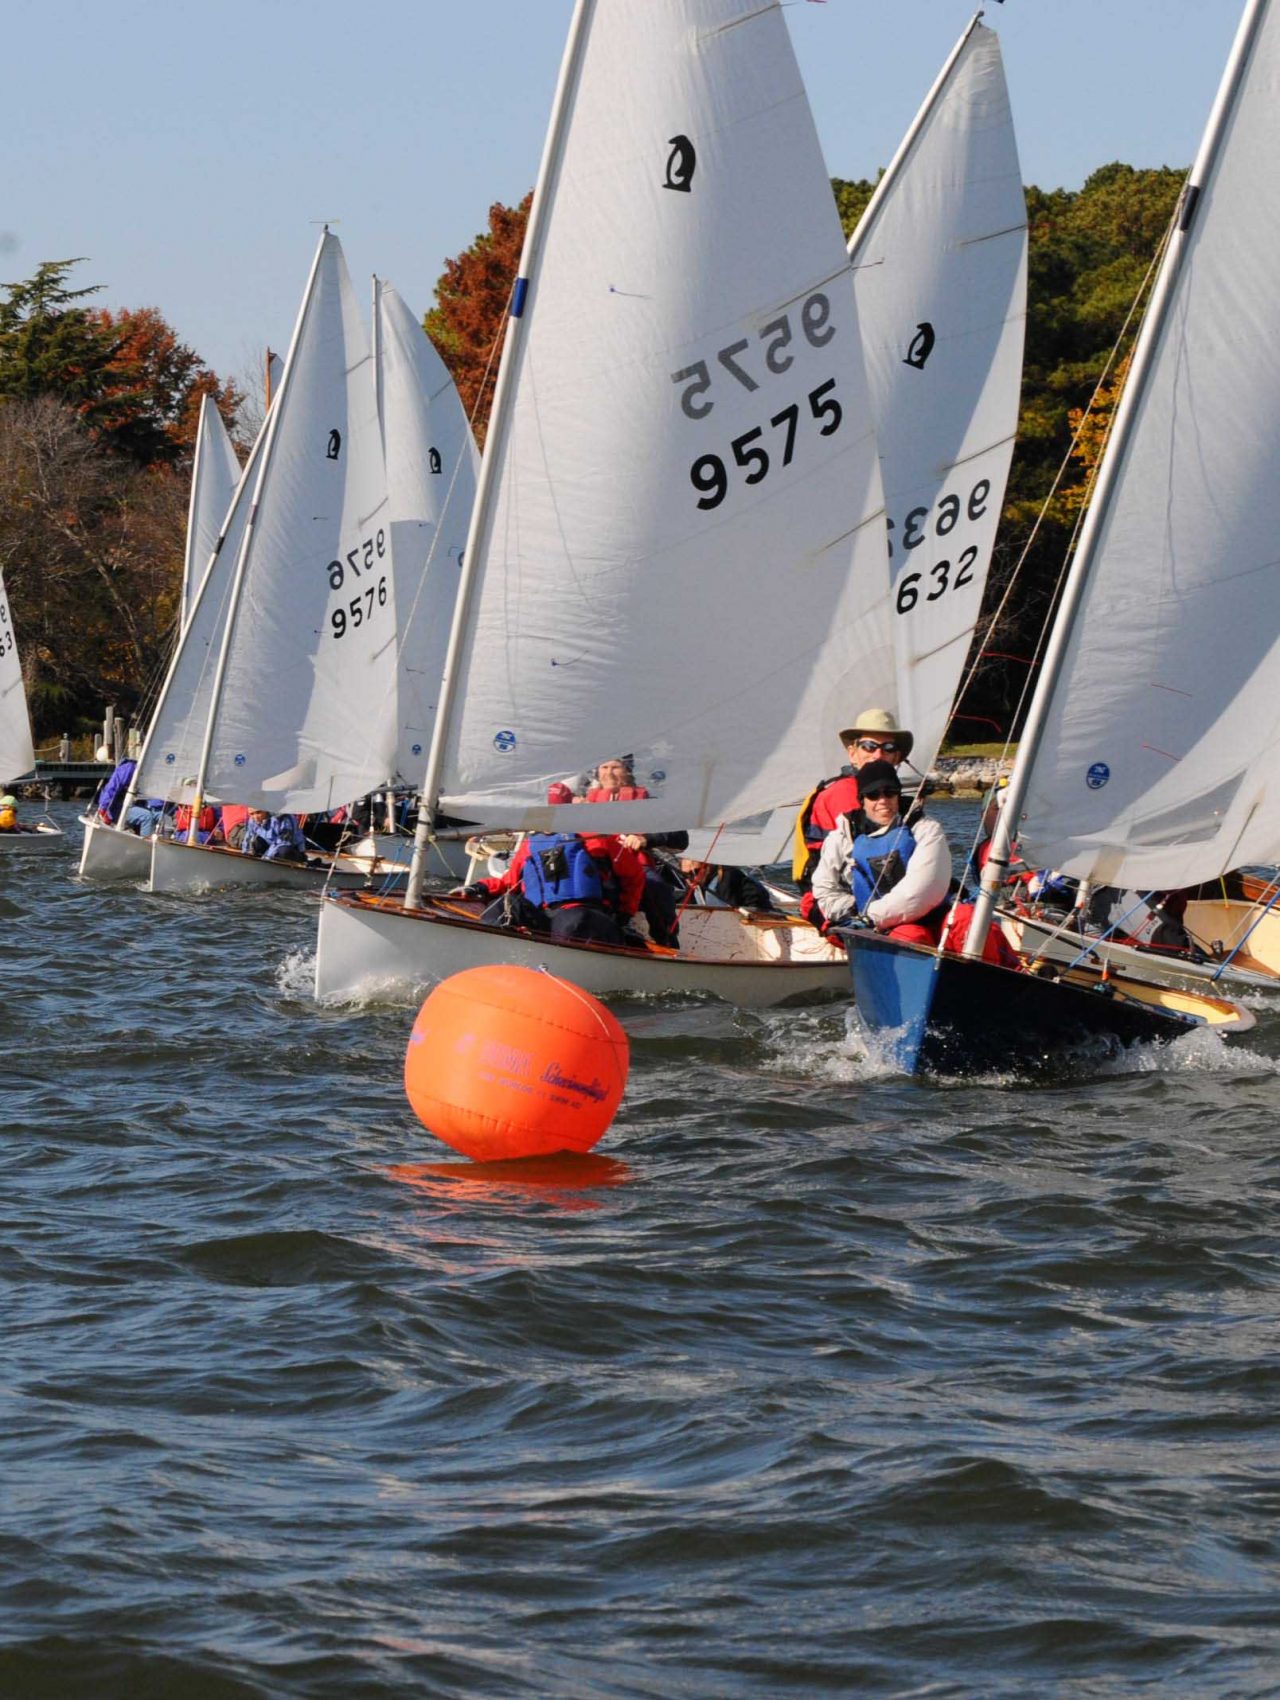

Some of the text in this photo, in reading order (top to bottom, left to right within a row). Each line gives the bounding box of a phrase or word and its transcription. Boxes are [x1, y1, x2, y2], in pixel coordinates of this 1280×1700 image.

[690, 378, 843, 511] 9575
[331, 576, 386, 639] 9576
[896, 545, 978, 614] 632
